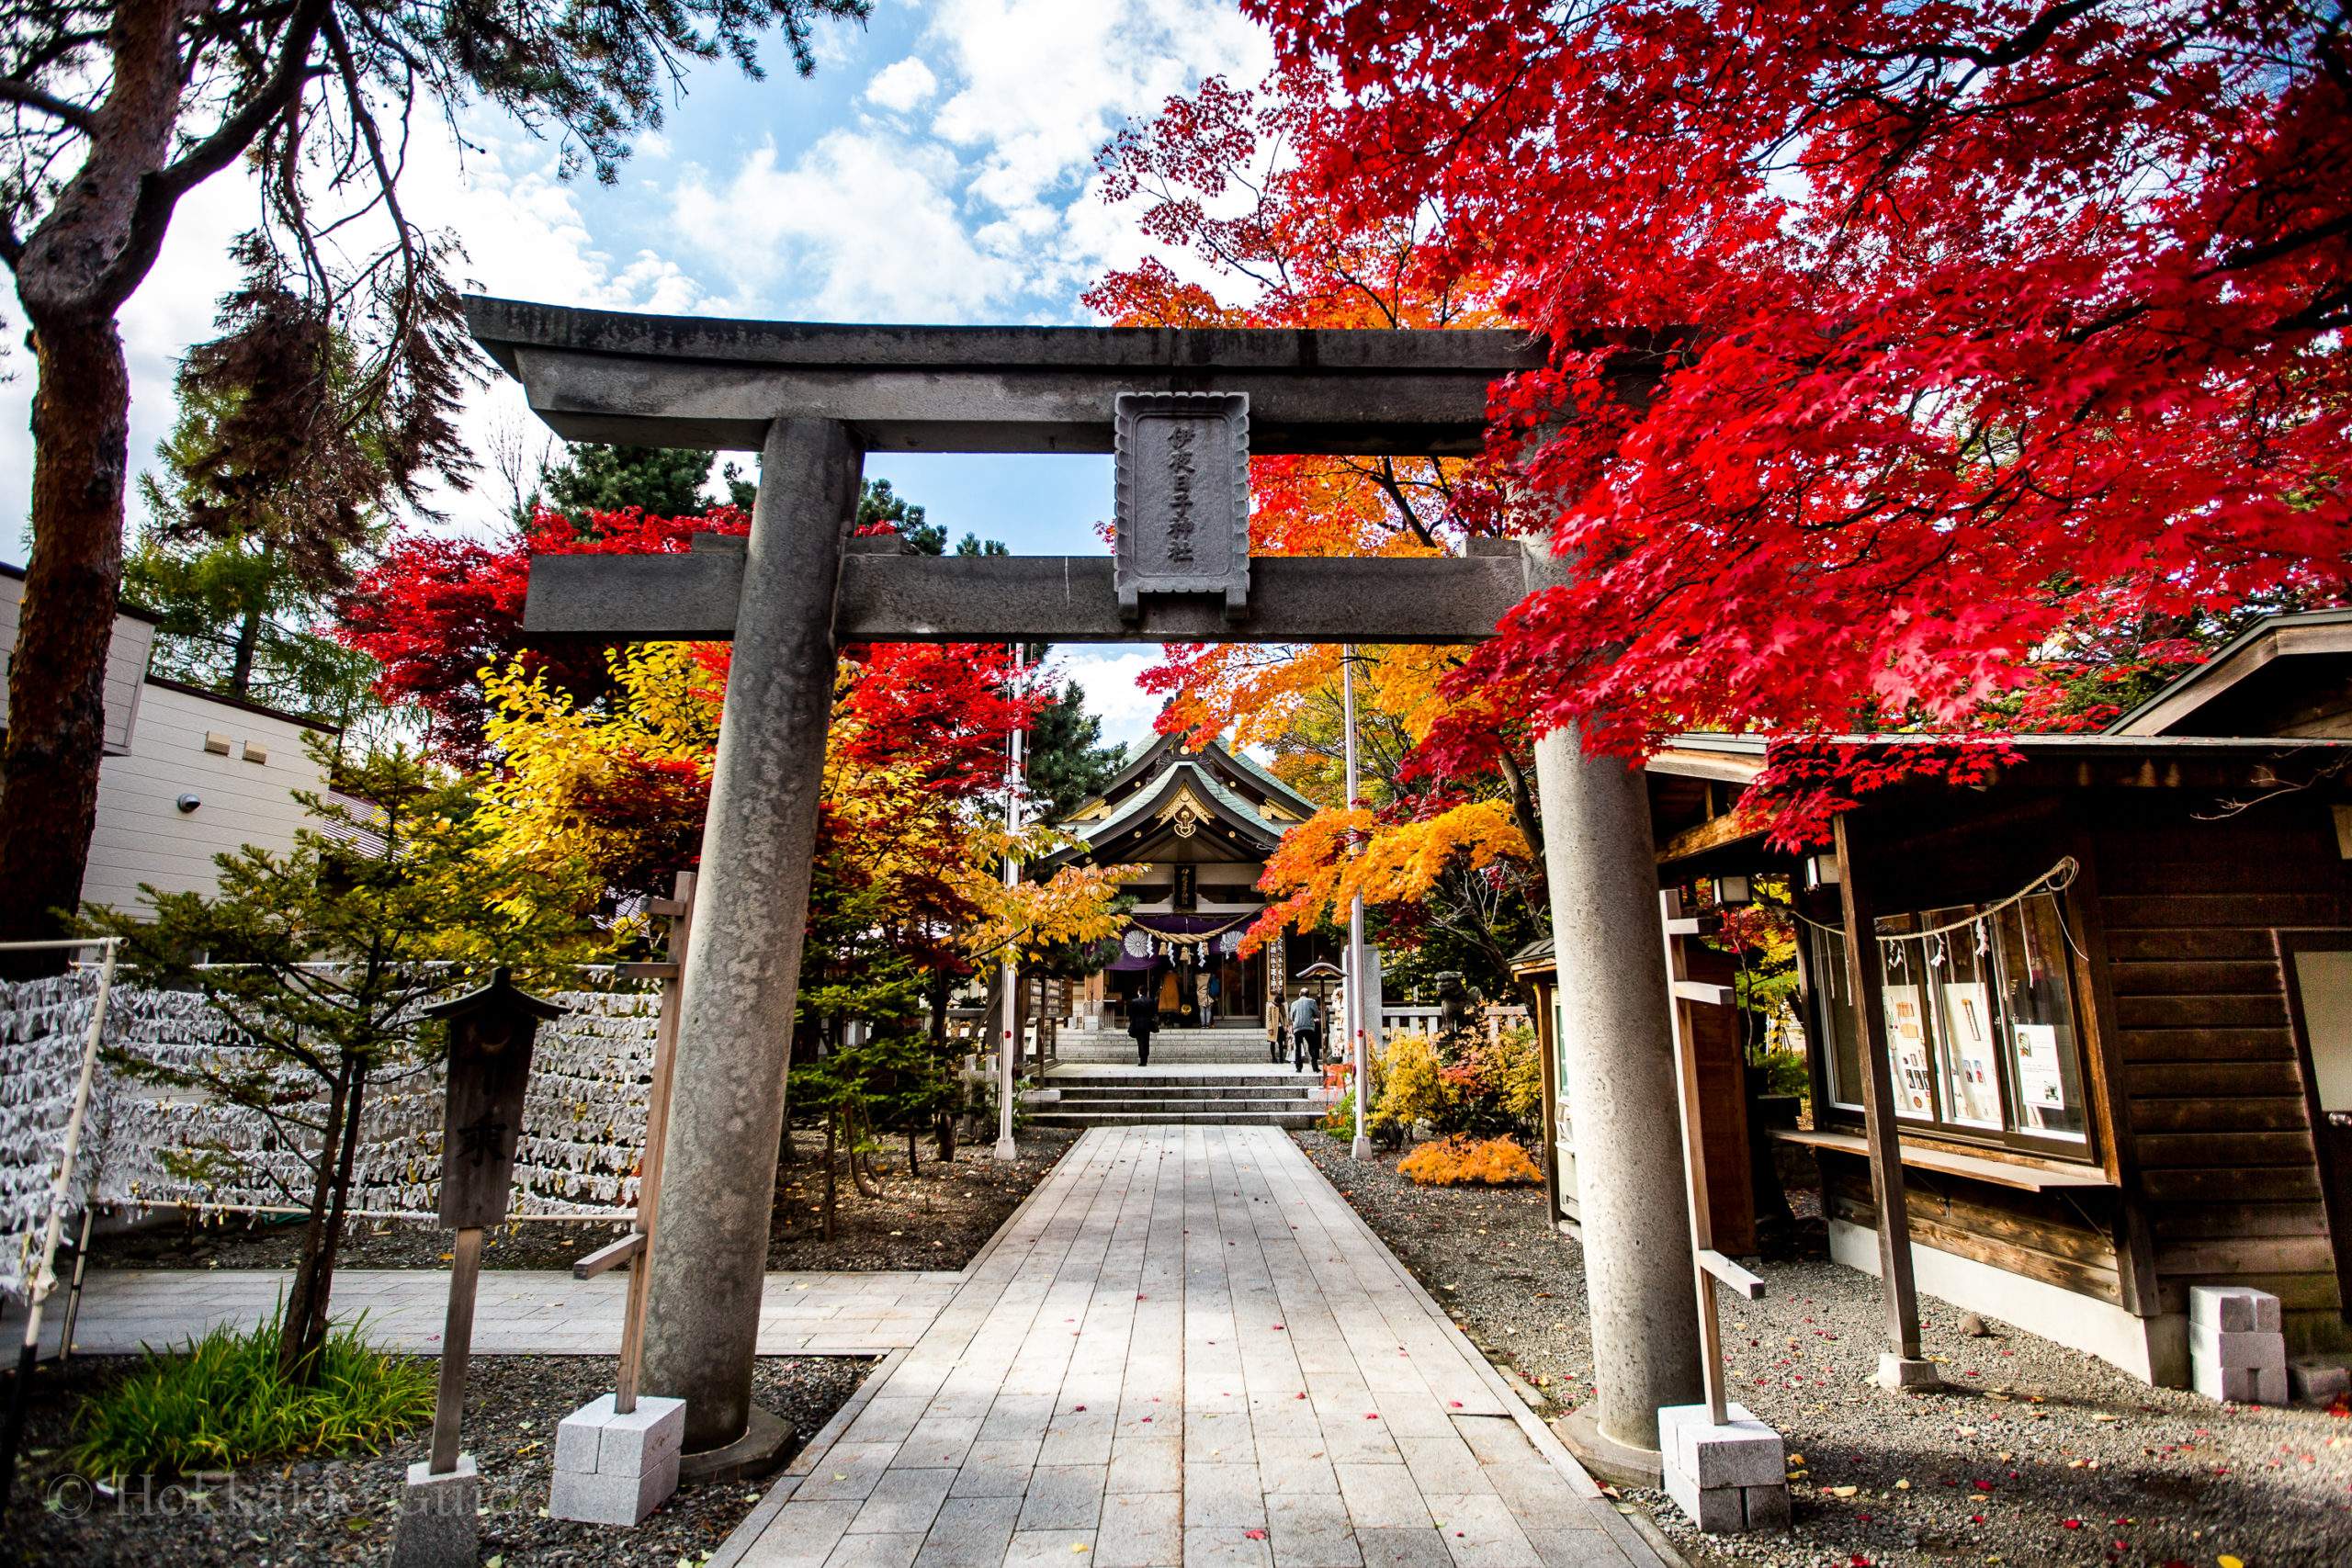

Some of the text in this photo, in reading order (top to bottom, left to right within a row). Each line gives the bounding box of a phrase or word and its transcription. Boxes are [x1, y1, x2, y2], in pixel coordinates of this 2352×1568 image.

[1167, 425, 1195, 563] 伊夜日子神社
